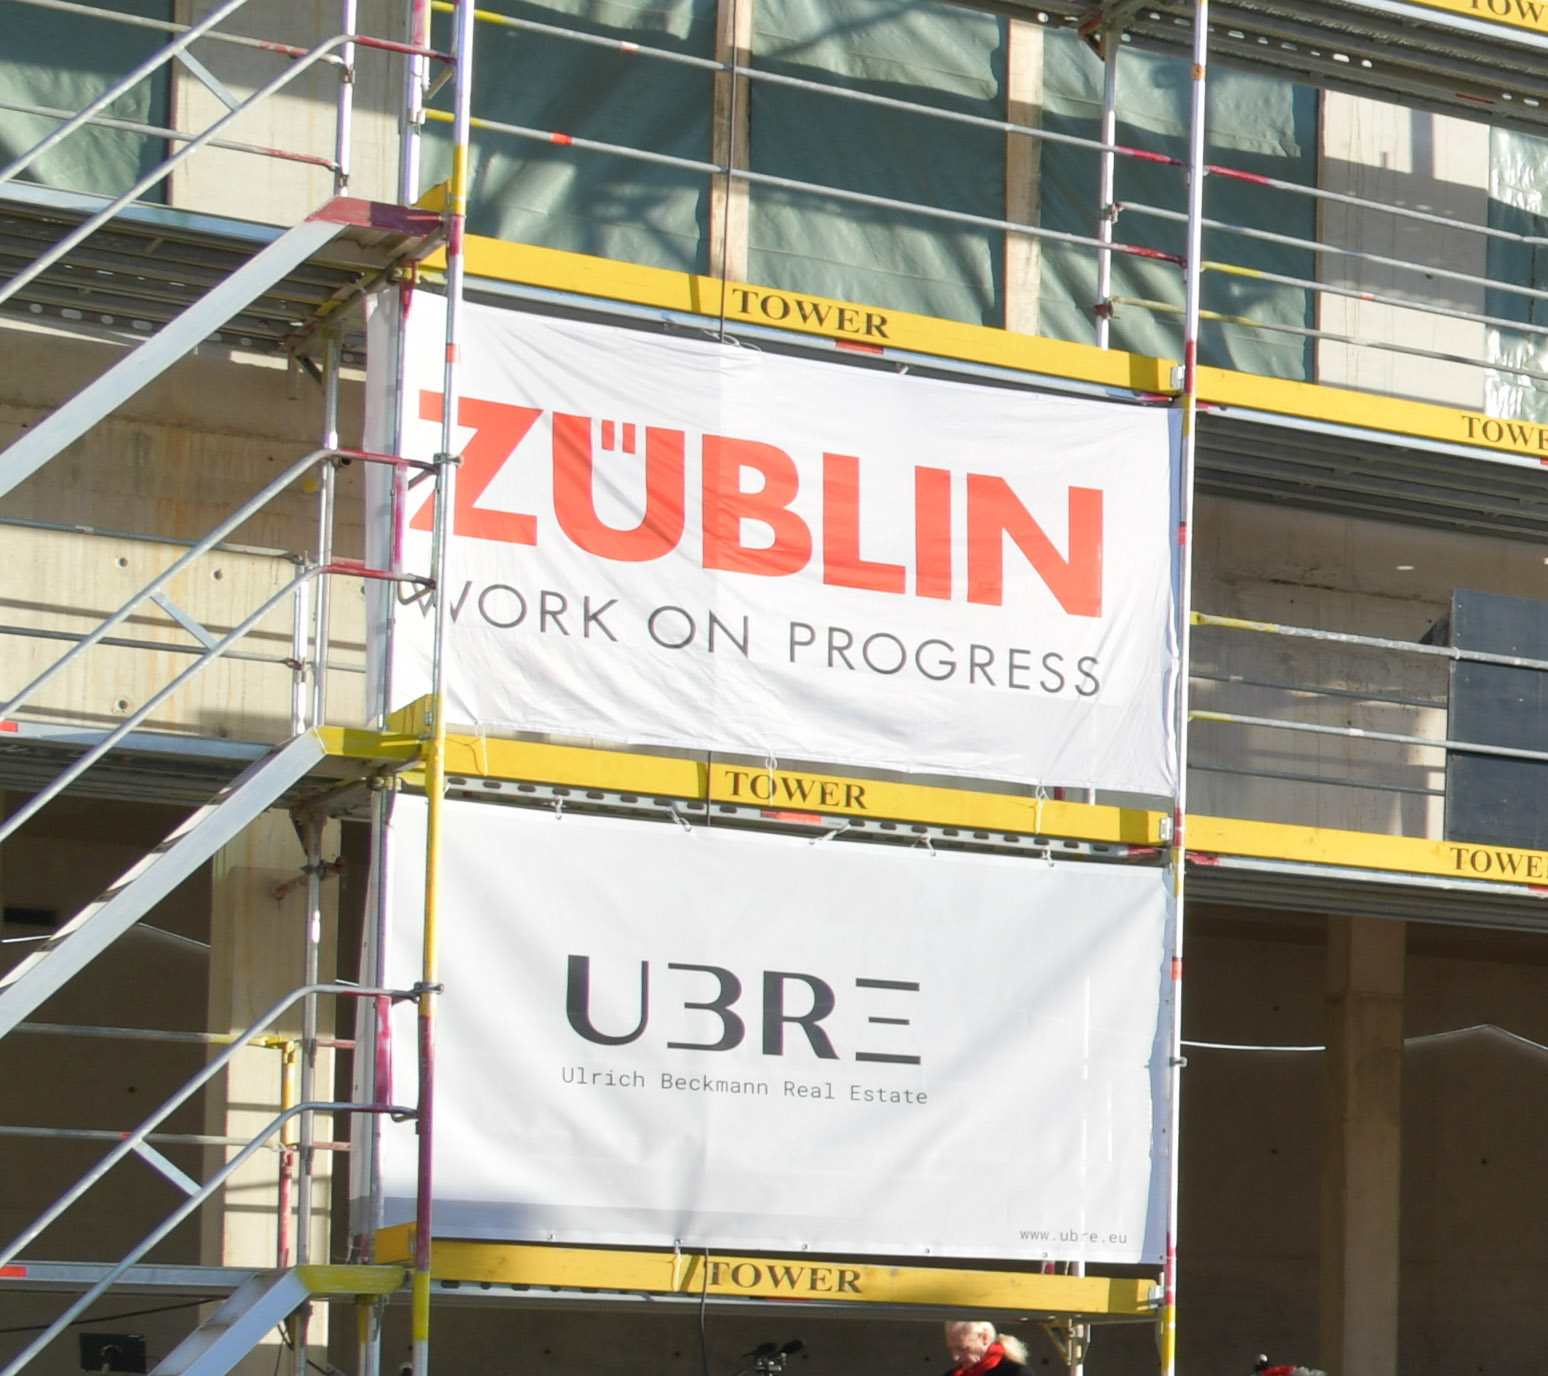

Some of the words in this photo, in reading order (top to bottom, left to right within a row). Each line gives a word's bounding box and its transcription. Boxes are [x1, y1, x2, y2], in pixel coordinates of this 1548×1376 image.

[731, 287, 890, 339] TOWER
[409, 389, 1103, 617] ZÜBLIN
[647, 605, 748, 657] ON
[789, 621, 1101, 698] PROGRESS
[723, 768, 868, 810] TOWER
[561, 1066, 646, 1089] Ulrich
[660, 1073, 769, 1095] Beckmann
[783, 1080, 836, 1101] Real
[849, 1085, 929, 1105] Estate
[703, 1261, 863, 1295] TOWER
